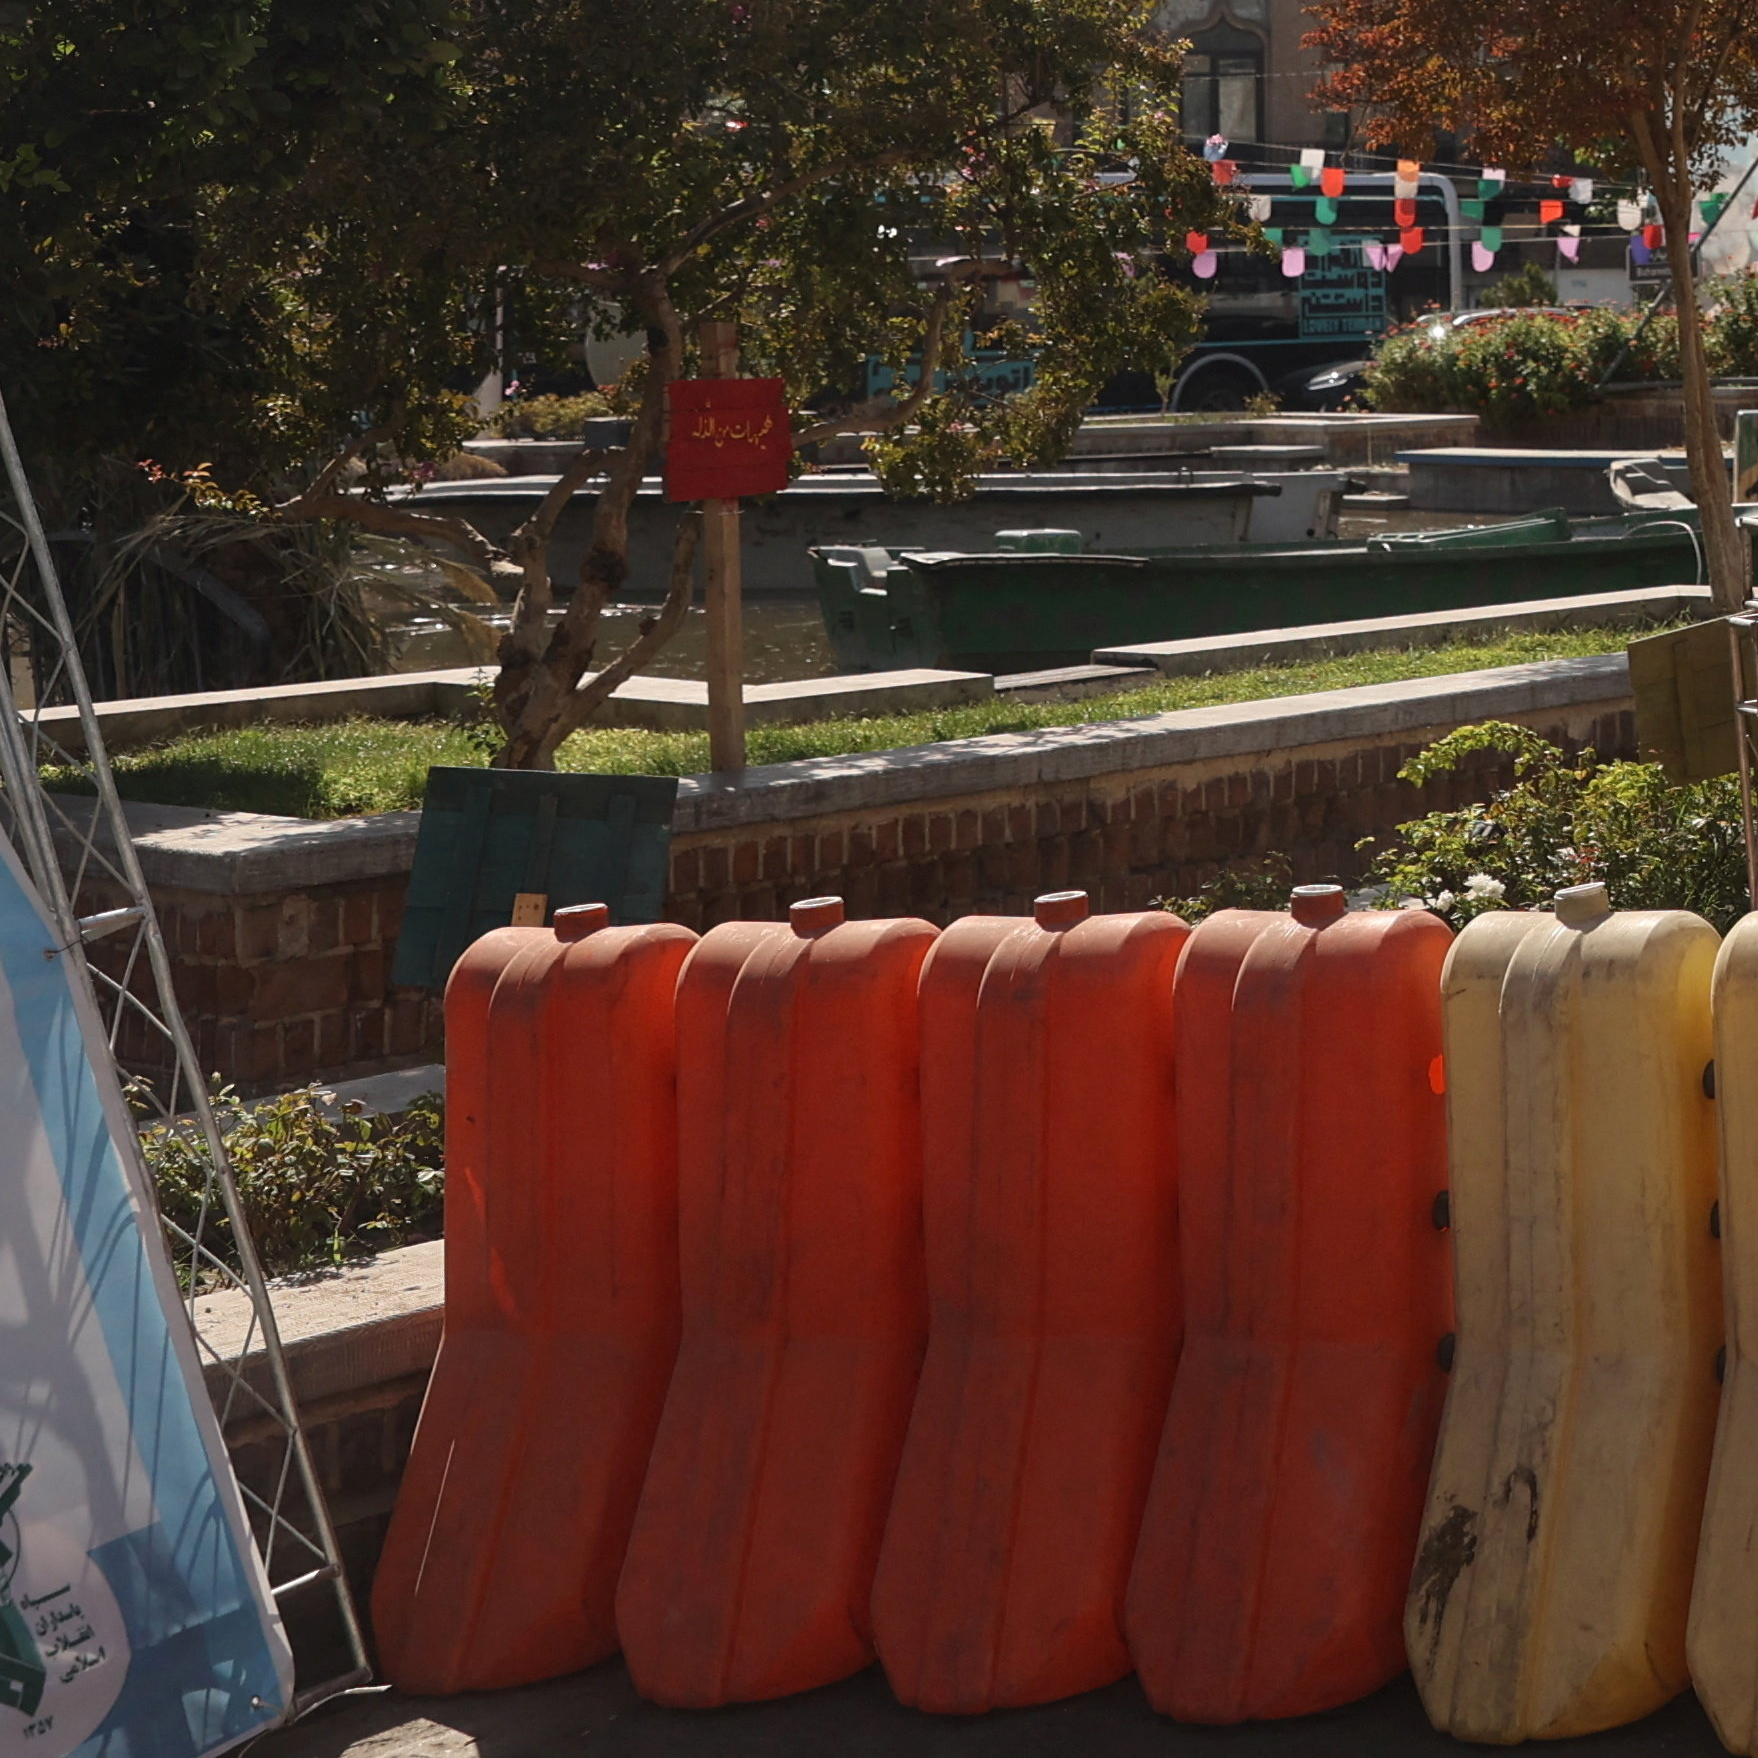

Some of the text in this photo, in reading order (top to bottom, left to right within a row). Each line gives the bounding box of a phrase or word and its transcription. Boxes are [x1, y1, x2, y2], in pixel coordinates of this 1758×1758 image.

[36, 1603, 84, 1638] پاسداران
[46, 1624, 95, 1661] انقلاب
[60, 1645, 106, 1684] اسلامی
